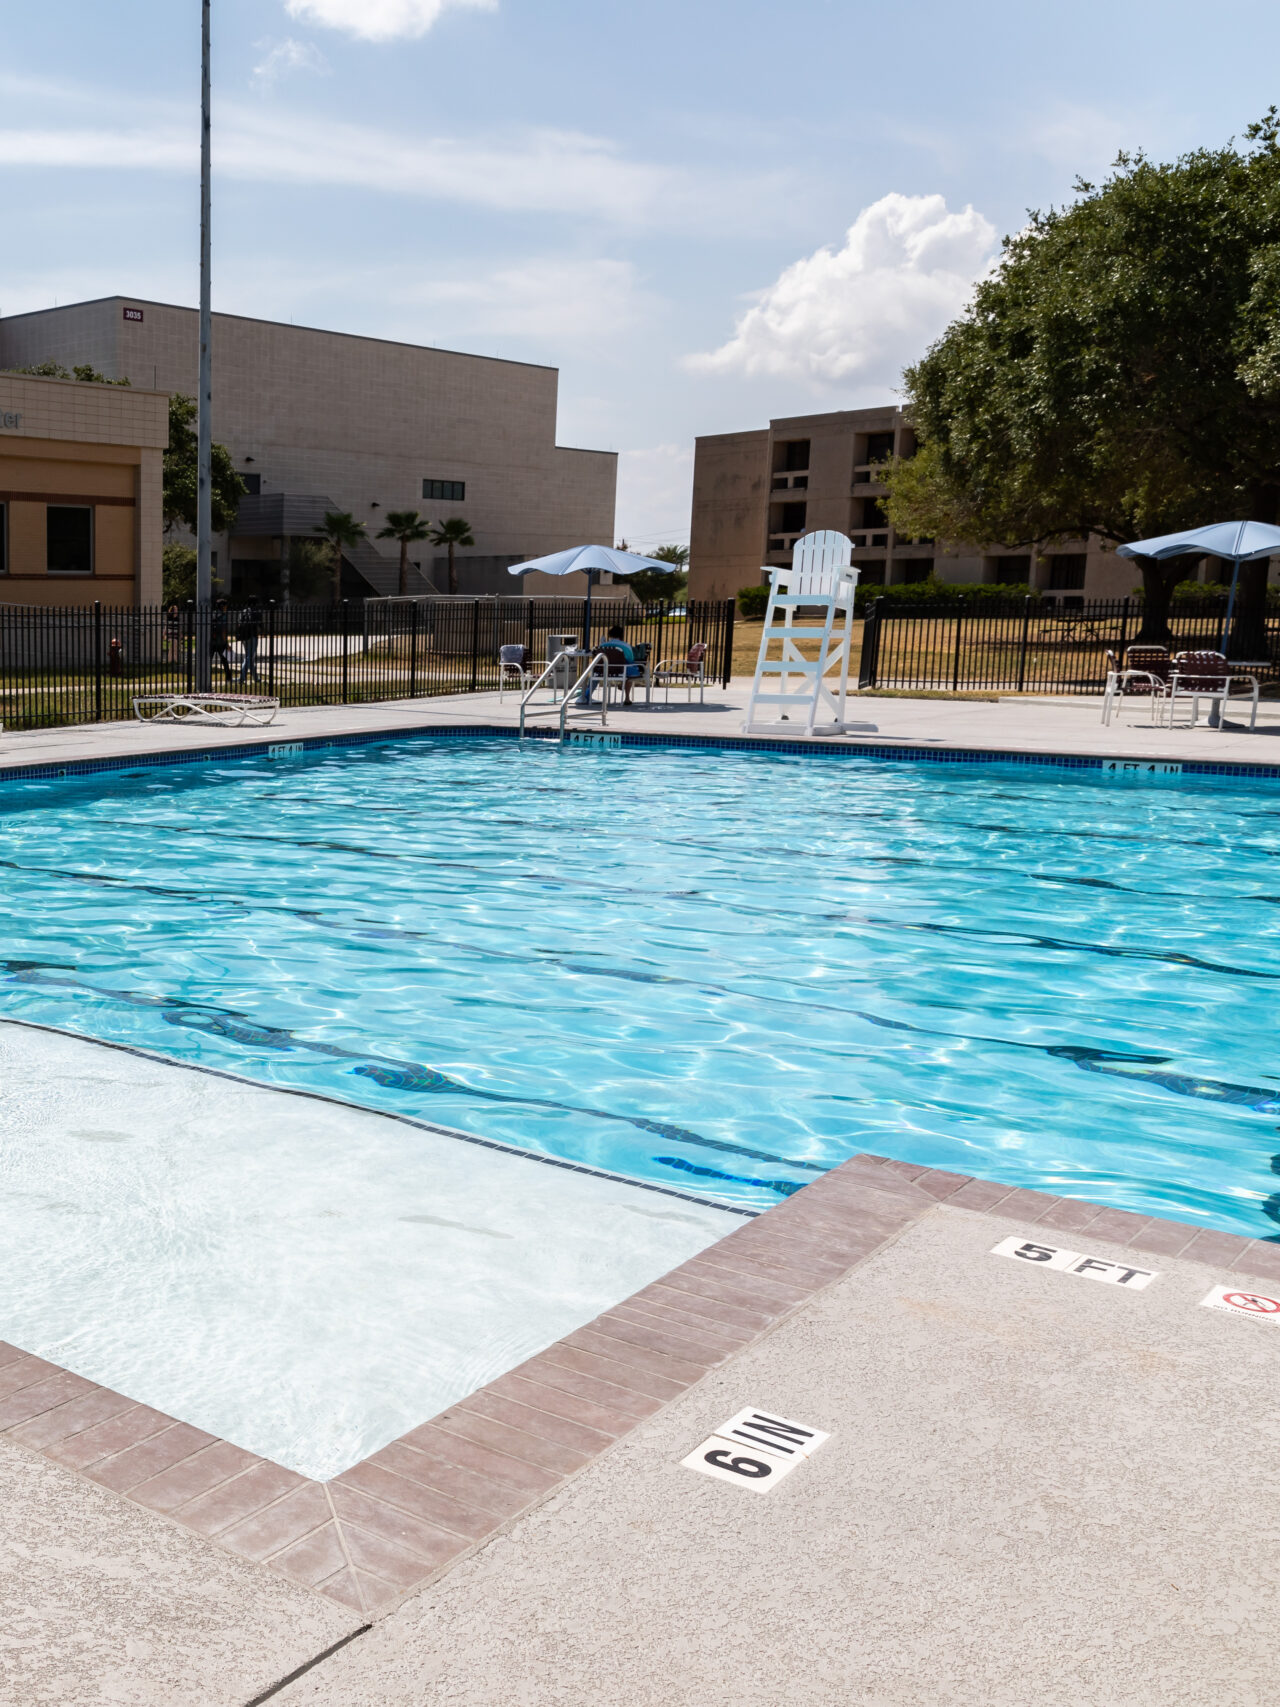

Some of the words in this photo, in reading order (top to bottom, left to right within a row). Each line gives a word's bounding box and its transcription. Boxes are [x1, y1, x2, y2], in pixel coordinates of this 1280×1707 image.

[126, 310, 142, 320] 3035
[609, 736, 620, 745] IN
[1163, 764, 1179, 774] IN
[1014, 1243, 1058, 1263] 5
[1073, 1258, 1151, 1284] FT
[731, 1413, 815, 1455] IN
[704, 1449, 773, 1479] 6
